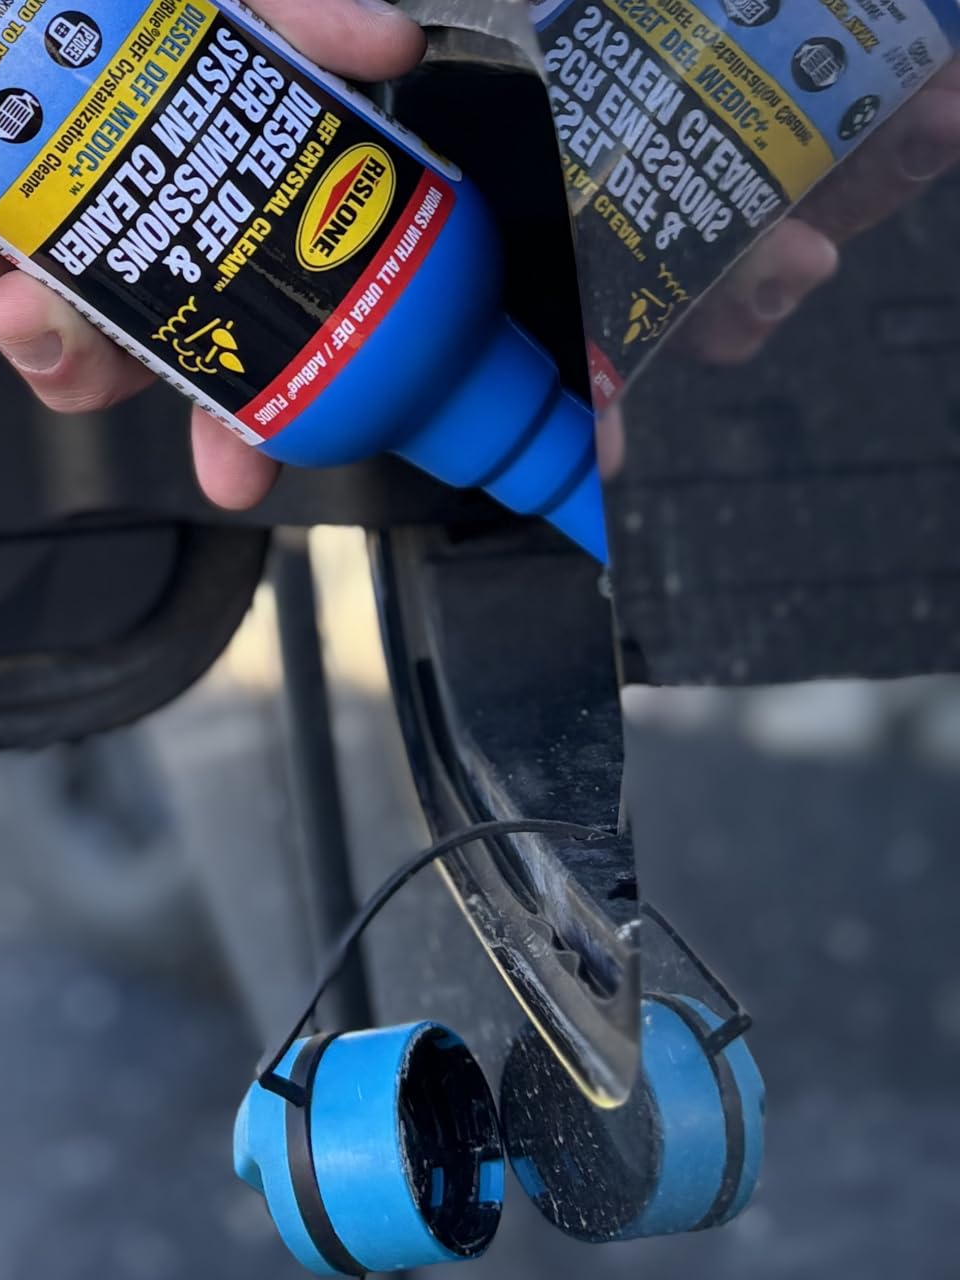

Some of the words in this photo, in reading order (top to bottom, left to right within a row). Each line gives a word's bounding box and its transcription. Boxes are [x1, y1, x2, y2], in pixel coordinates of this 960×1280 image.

[63, 26, 93, 61] P20EE
[153, 2, 207, 62] DIESEL
[53, 57, 135, 154] Crystallization
[127, 59, 169, 107] DEF
[149, 27, 249, 158] SYSTEM
[228, 55, 286, 125] SCR
[234, 80, 322, 190] DIESEL
[314, 110, 342, 145] DEF
[18, 152, 62, 198] Cleaner
[105, 106, 252, 282] EMISSIONS
[261, 139, 326, 213] CRYSTAL
[47, 144, 163, 275] CLEANER
[190, 178, 256, 264] DEF
[412, 185, 442, 230] WORKS
[160, 244, 202, 285] &
[392, 223, 422, 262] WITH
[375, 254, 398, 282] ALL
[348, 281, 384, 321] UREA
[323, 341, 333, 359] /
[329, 317, 356, 350] DEF
[253, 392, 289, 426] FLUIDS
